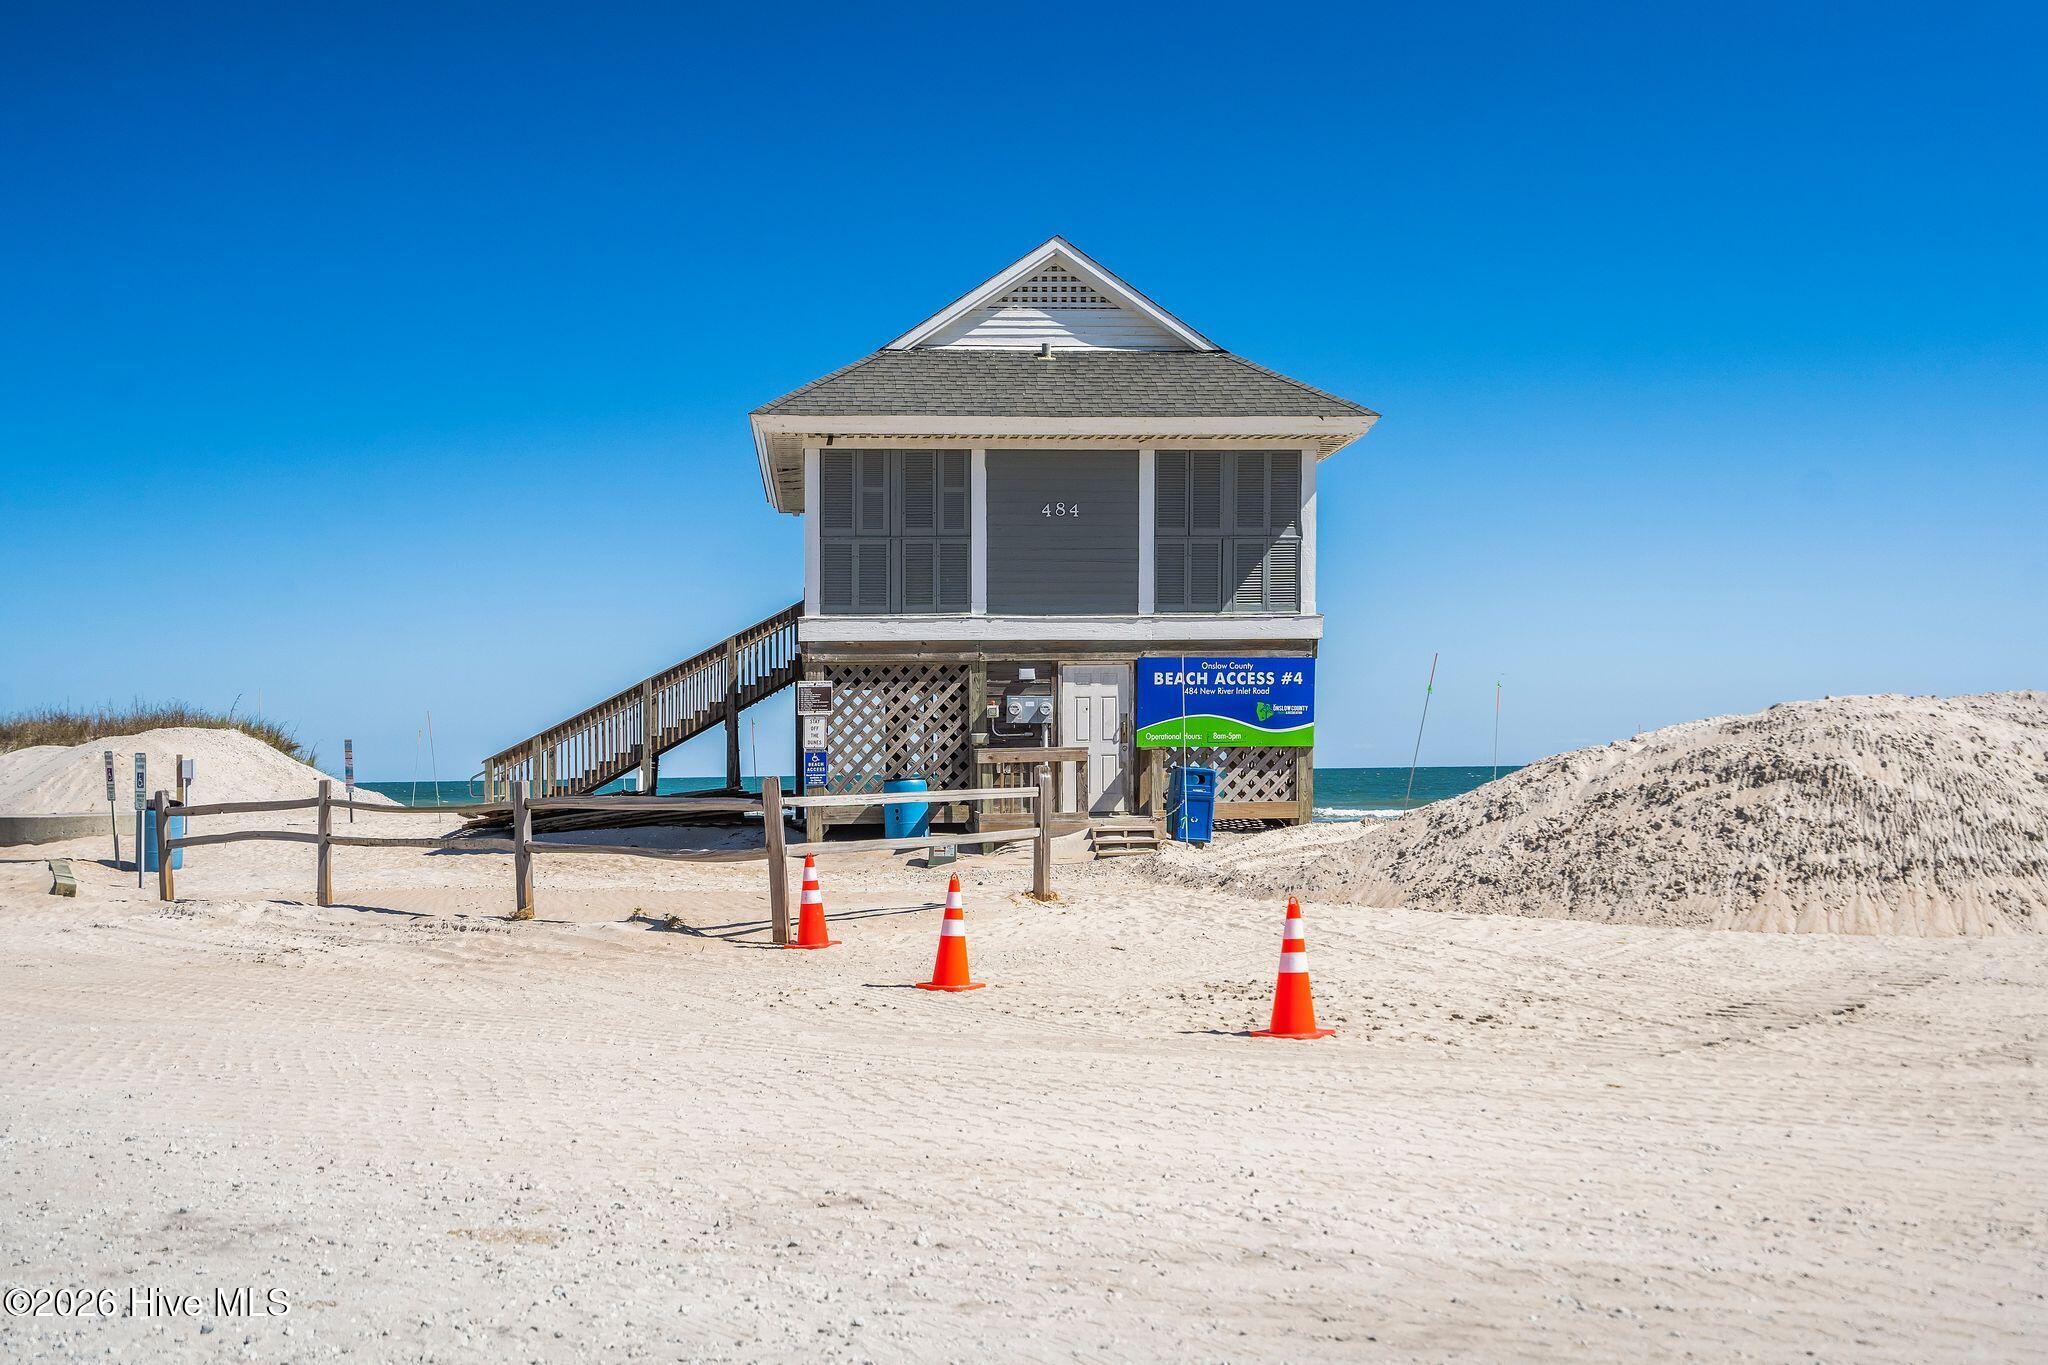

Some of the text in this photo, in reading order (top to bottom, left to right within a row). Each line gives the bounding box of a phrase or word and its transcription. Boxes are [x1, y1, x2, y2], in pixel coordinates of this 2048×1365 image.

[1041, 502, 1079, 517] 484
[1201, 661, 1254, 671] Onslow County
[1153, 671, 1303, 685] BEACH ACCESS #4
[1184, 687, 1270, 695] 484 New River Inlet Road
[1145, 732, 1182, 741] Operational
